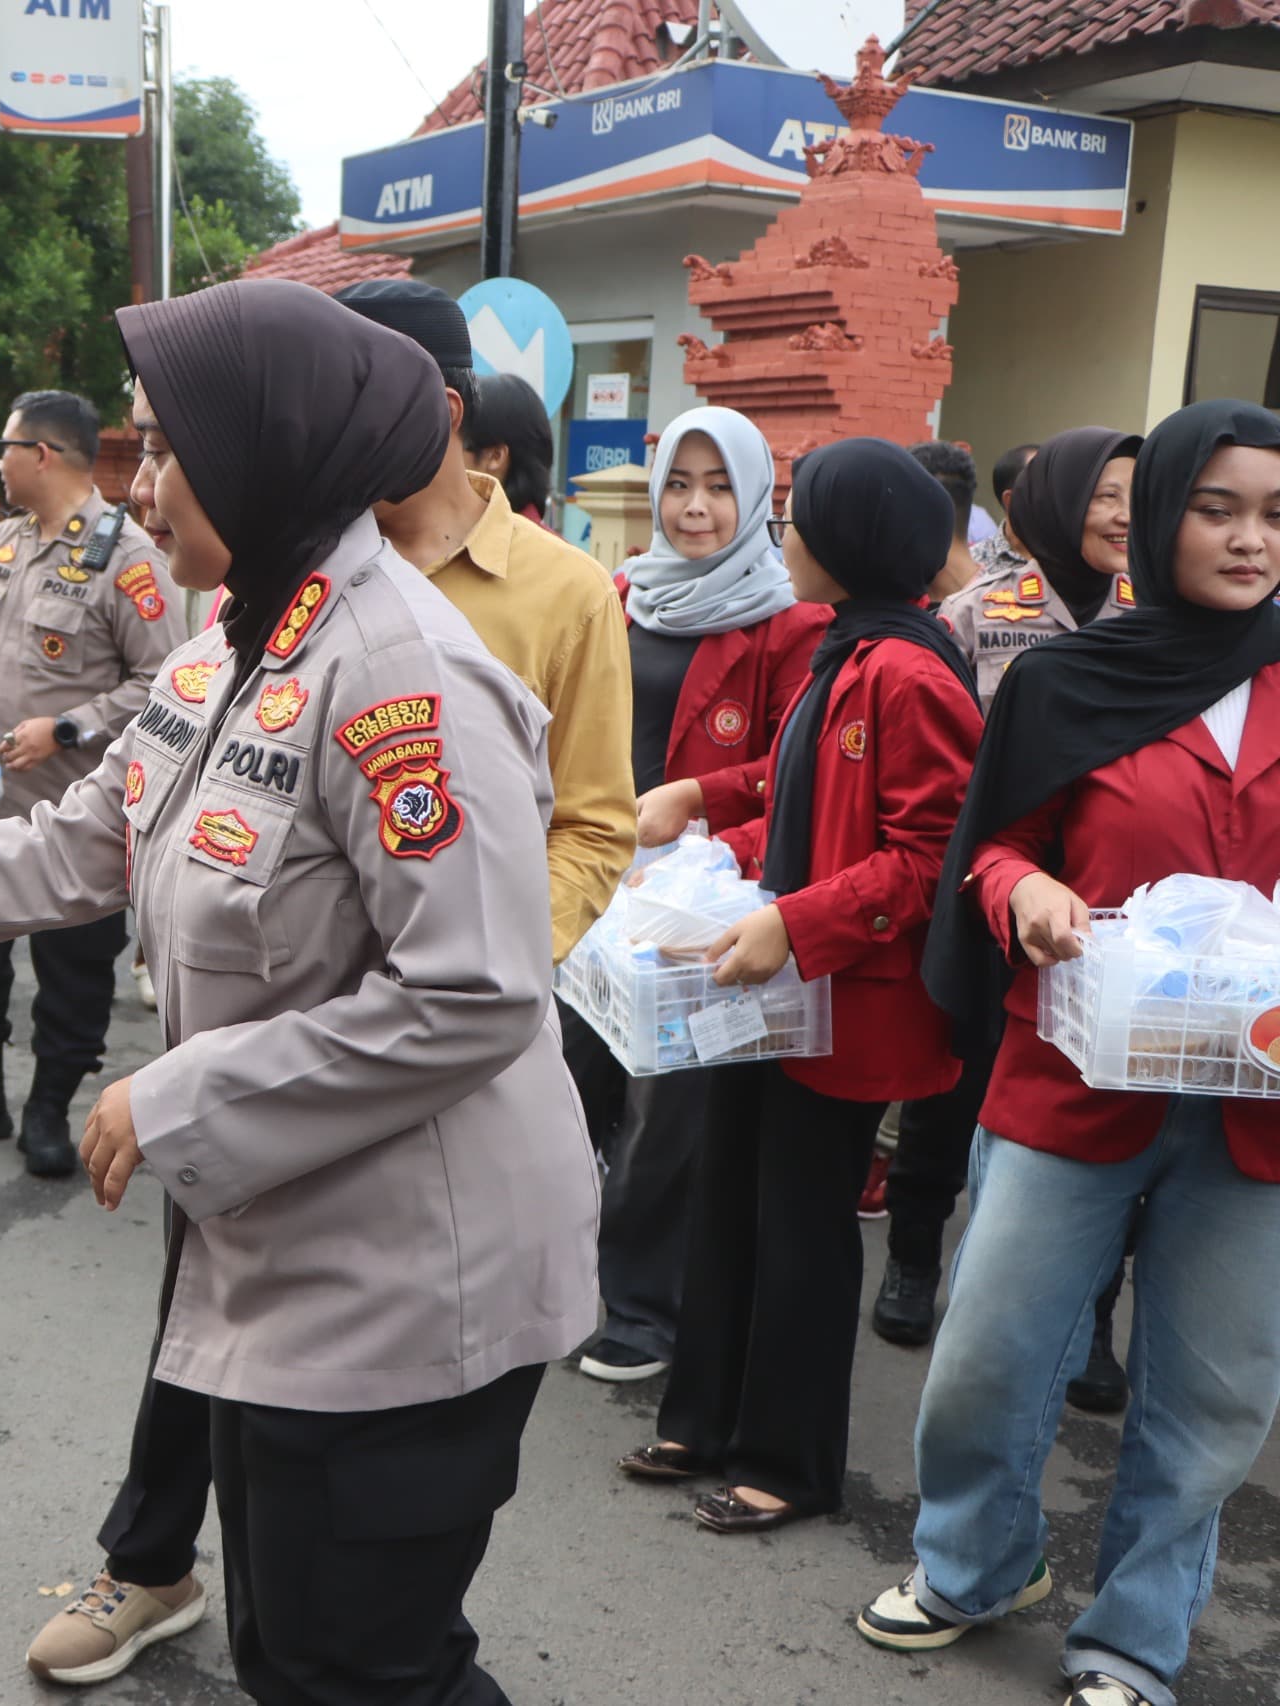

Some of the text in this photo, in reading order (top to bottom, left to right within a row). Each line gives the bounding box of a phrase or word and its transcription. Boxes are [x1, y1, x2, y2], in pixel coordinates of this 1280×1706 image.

[615, 89, 681, 122] BANK BRI
[768, 118, 851, 163] AT
[1031, 126, 1107, 153] BANK BRI
[375, 173, 433, 218] ATM
[42, 579, 89, 600] POLRI
[344, 698, 432, 743] POLRESTA
[353, 712, 429, 747] CIREBON
[216, 739, 300, 794] POLRI
